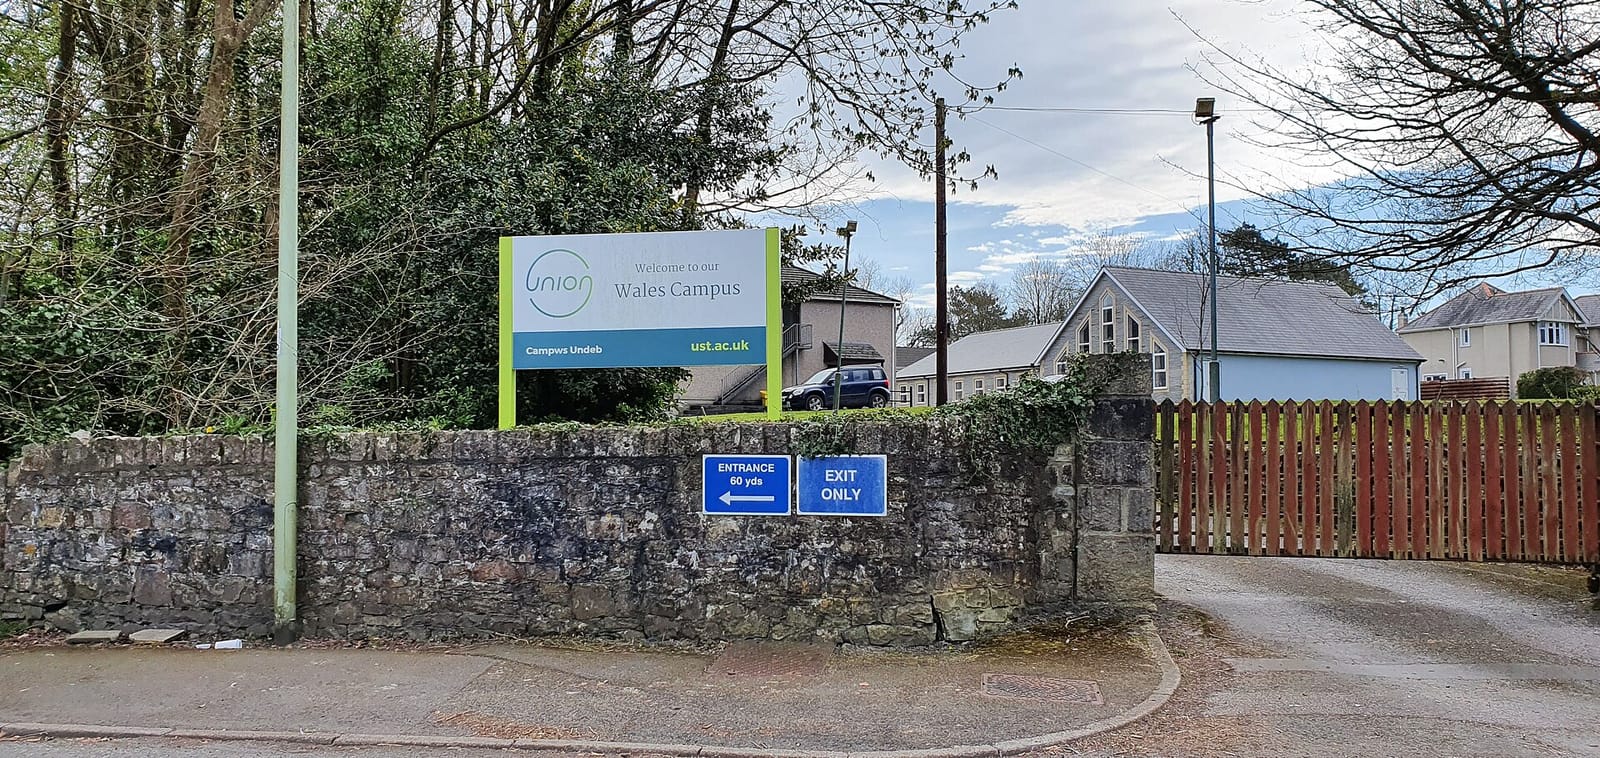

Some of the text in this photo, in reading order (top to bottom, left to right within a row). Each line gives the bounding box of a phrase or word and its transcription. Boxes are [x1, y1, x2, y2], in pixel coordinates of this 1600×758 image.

[634, 262, 720, 273] Welcome to our
[615, 281, 741, 300] Wales Campus
[526, 345, 602, 356] Campws Undeb
[691, 340, 749, 352] ust.ac.uk
[718, 463, 775, 472] ENTRANCE
[730, 476, 763, 488] 60 yds
[825, 470, 857, 482] EXIT
[821, 488, 861, 501] ONLY
